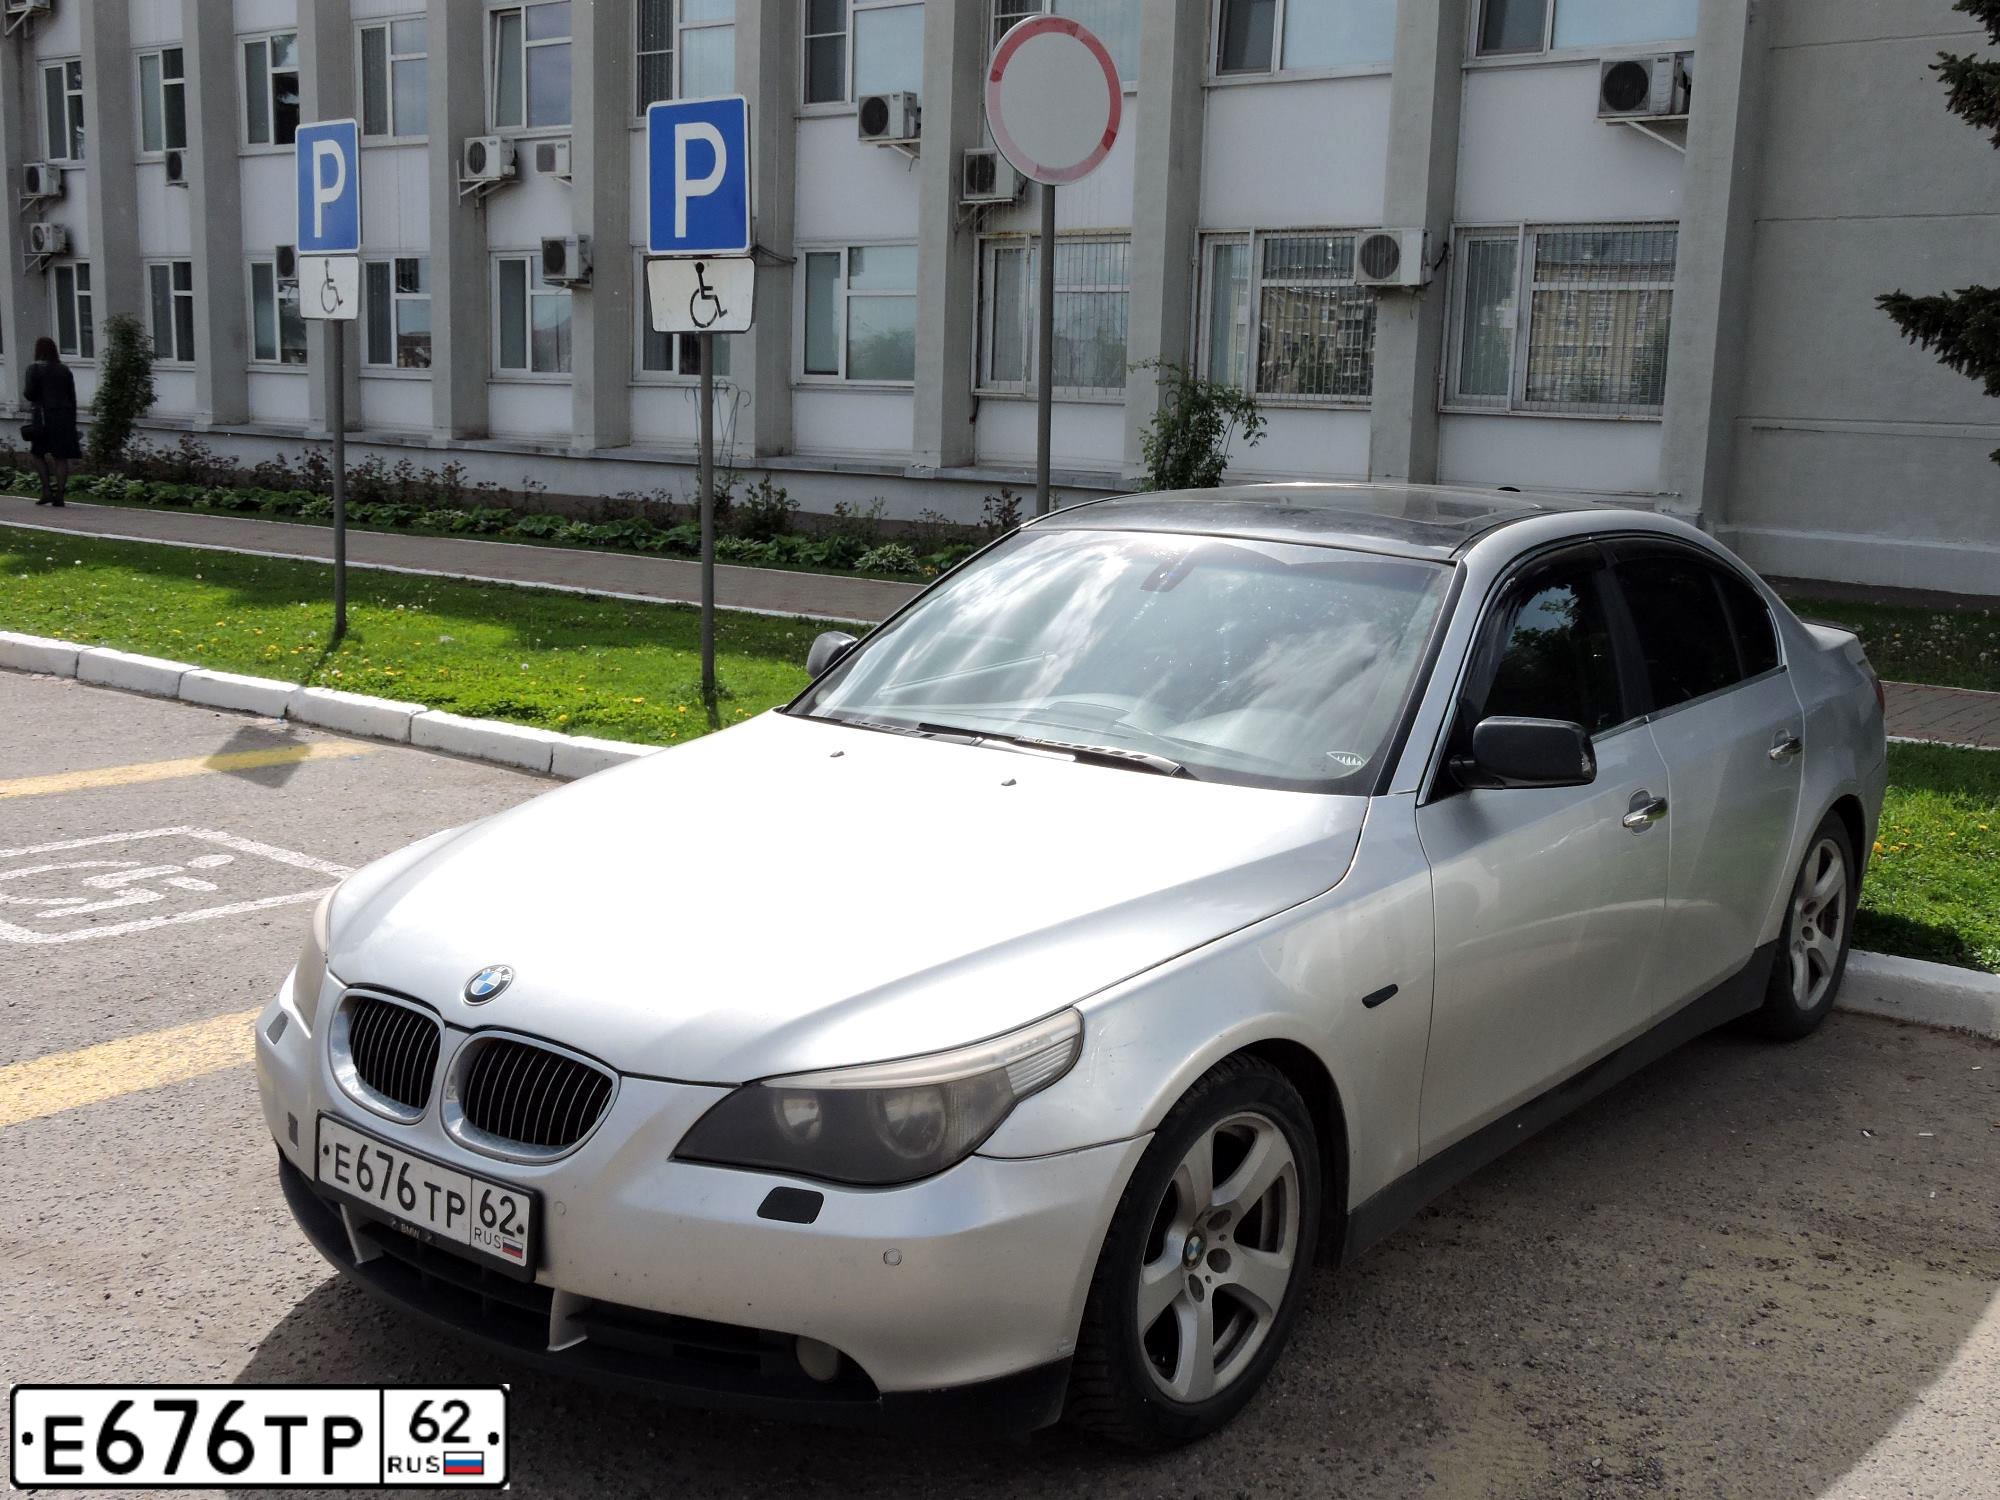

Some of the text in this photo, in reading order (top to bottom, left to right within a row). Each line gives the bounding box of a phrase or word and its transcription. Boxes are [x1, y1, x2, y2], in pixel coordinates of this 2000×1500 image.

[312, 138, 346, 239] P
[674, 121, 727, 239] P
[334, 1141, 466, 1229] E676TP
[479, 1188, 516, 1238] 62
[474, 1227, 502, 1249] RUS
